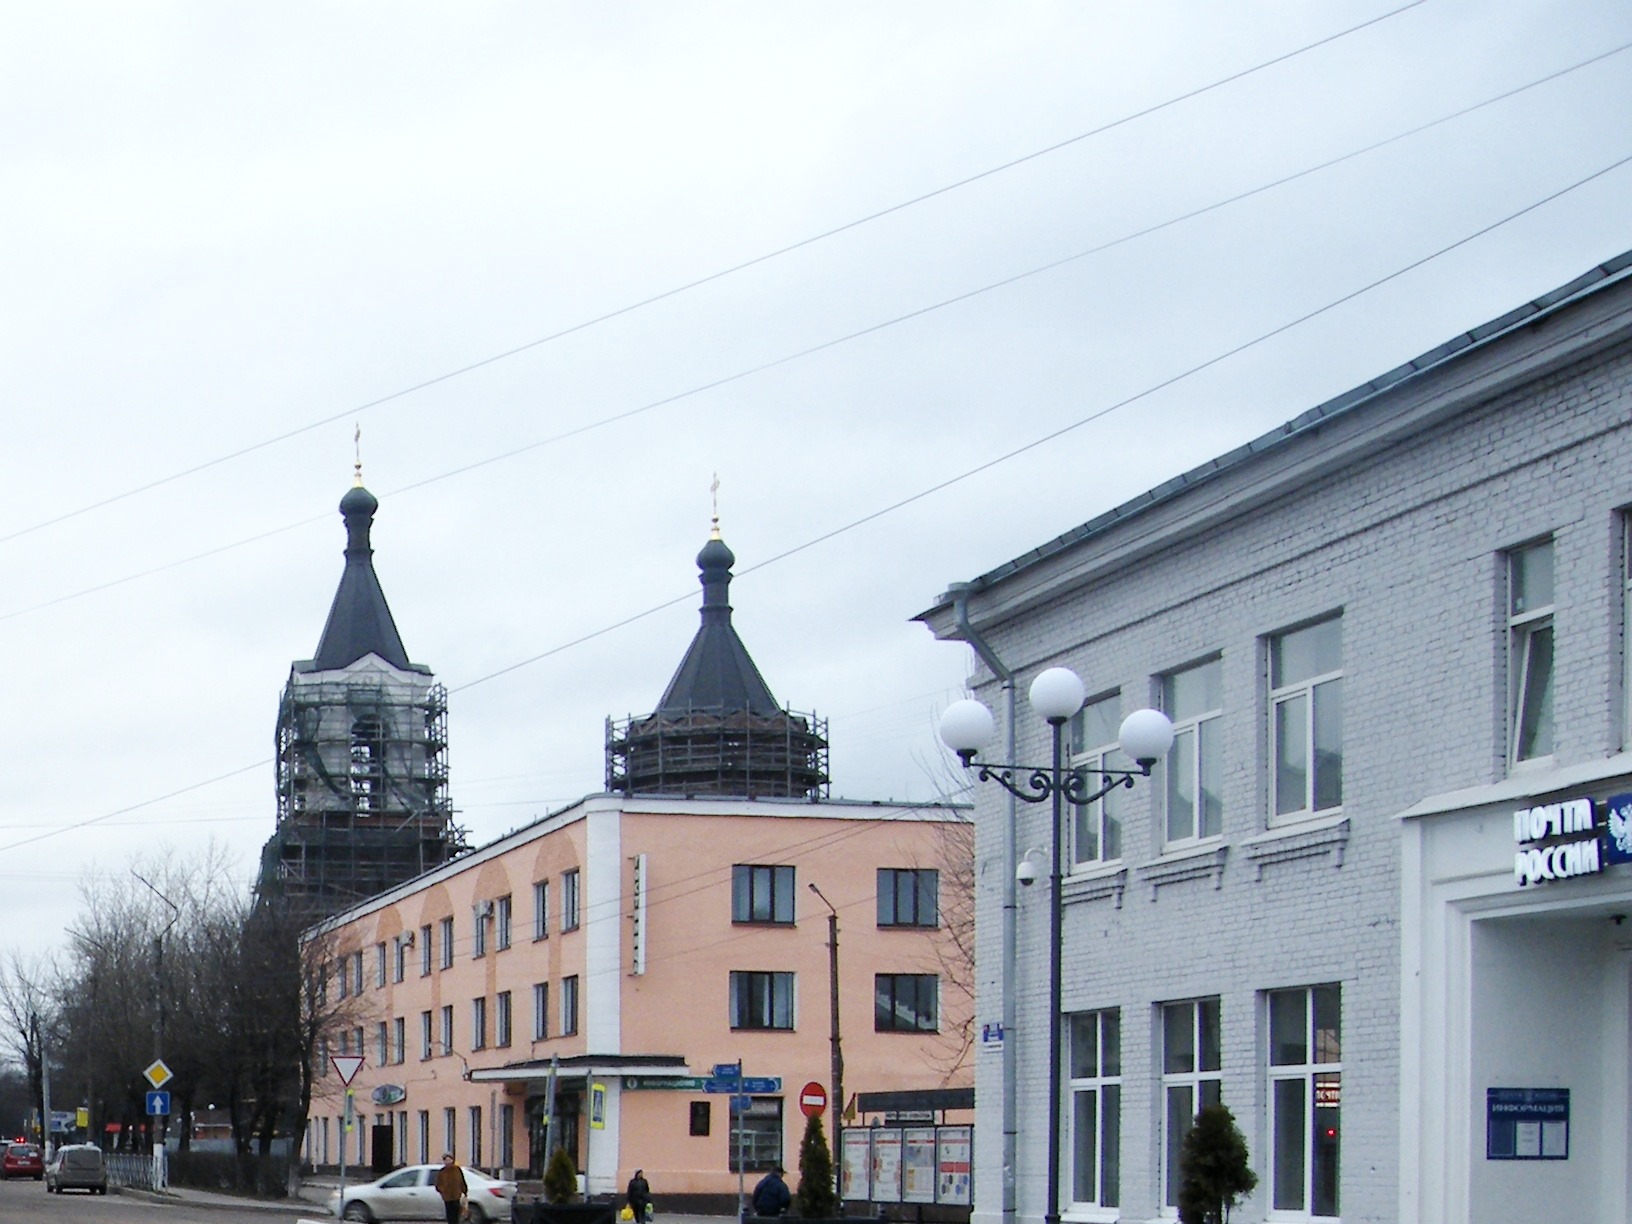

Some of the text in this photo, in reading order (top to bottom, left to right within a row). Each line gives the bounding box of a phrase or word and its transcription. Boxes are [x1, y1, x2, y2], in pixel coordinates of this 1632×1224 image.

[1513, 798, 1594, 842] ПОЧТА
[1514, 838, 1601, 884] РОССИИ
[1492, 1103, 1565, 1114] ИНФОРМАЦИЯ
